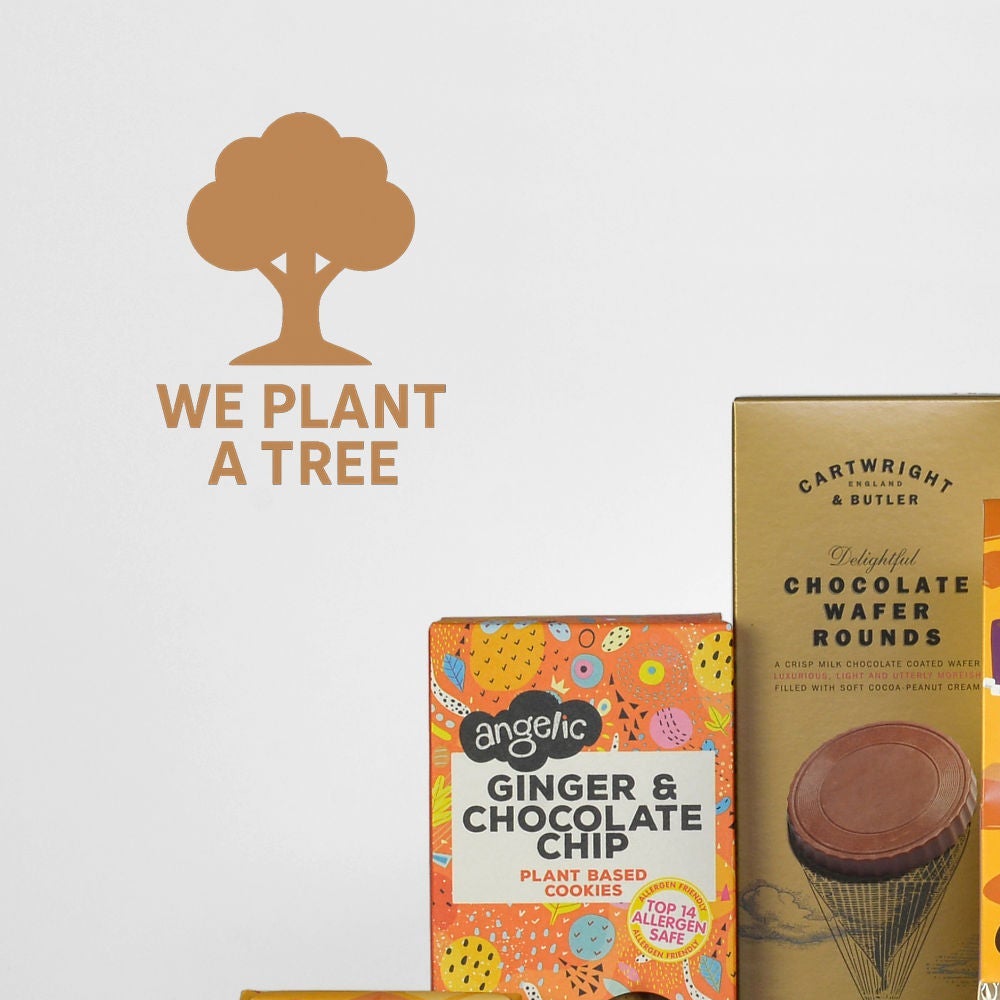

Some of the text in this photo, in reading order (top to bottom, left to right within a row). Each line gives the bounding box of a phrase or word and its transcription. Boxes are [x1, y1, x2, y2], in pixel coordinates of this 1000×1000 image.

[798, 458, 953, 494] CARTWRIGHT
[832, 494, 918, 505] & BUTLER
[828, 545, 920, 573] Delightful
[784, 576, 969, 595] CHOCOLATE
[825, 603, 929, 620] WAFER
[813, 629, 941, 646] ROUNDS
[774, 661, 781, 669] A
[785, 661, 814, 669] CRISP
[846, 660, 902, 668] CHOCOLATE
[906, 660, 943, 668] COATED
[948, 659, 980, 667] WAFER
[836, 672, 864, 680] LIGHT
[869, 672, 888, 680] AND
[893, 672, 932, 680] UTTERLY
[774, 684, 807, 692] FILLED
[812, 684, 835, 692] WITH
[840, 684, 864, 692] SOFT
[947, 683, 980, 691] CREAM
[475, 711, 588, 758] angelic
[487, 773, 677, 802] GINGER &
[462, 804, 703, 833] CHOCOLATE
[536, 832, 629, 860] CHIP
[520, 869, 647, 882] PLANT BASED
[544, 884, 623, 897] COOKIES
[639, 881, 707, 911] ALLERGEN FRIENDLY
[647, 899, 696, 919] TOP 14
[632, 911, 707, 934] ALLERGEN
[633, 929, 699, 959] ALLERGEN FRIENDLY
[649, 928, 685, 945] SAFE
